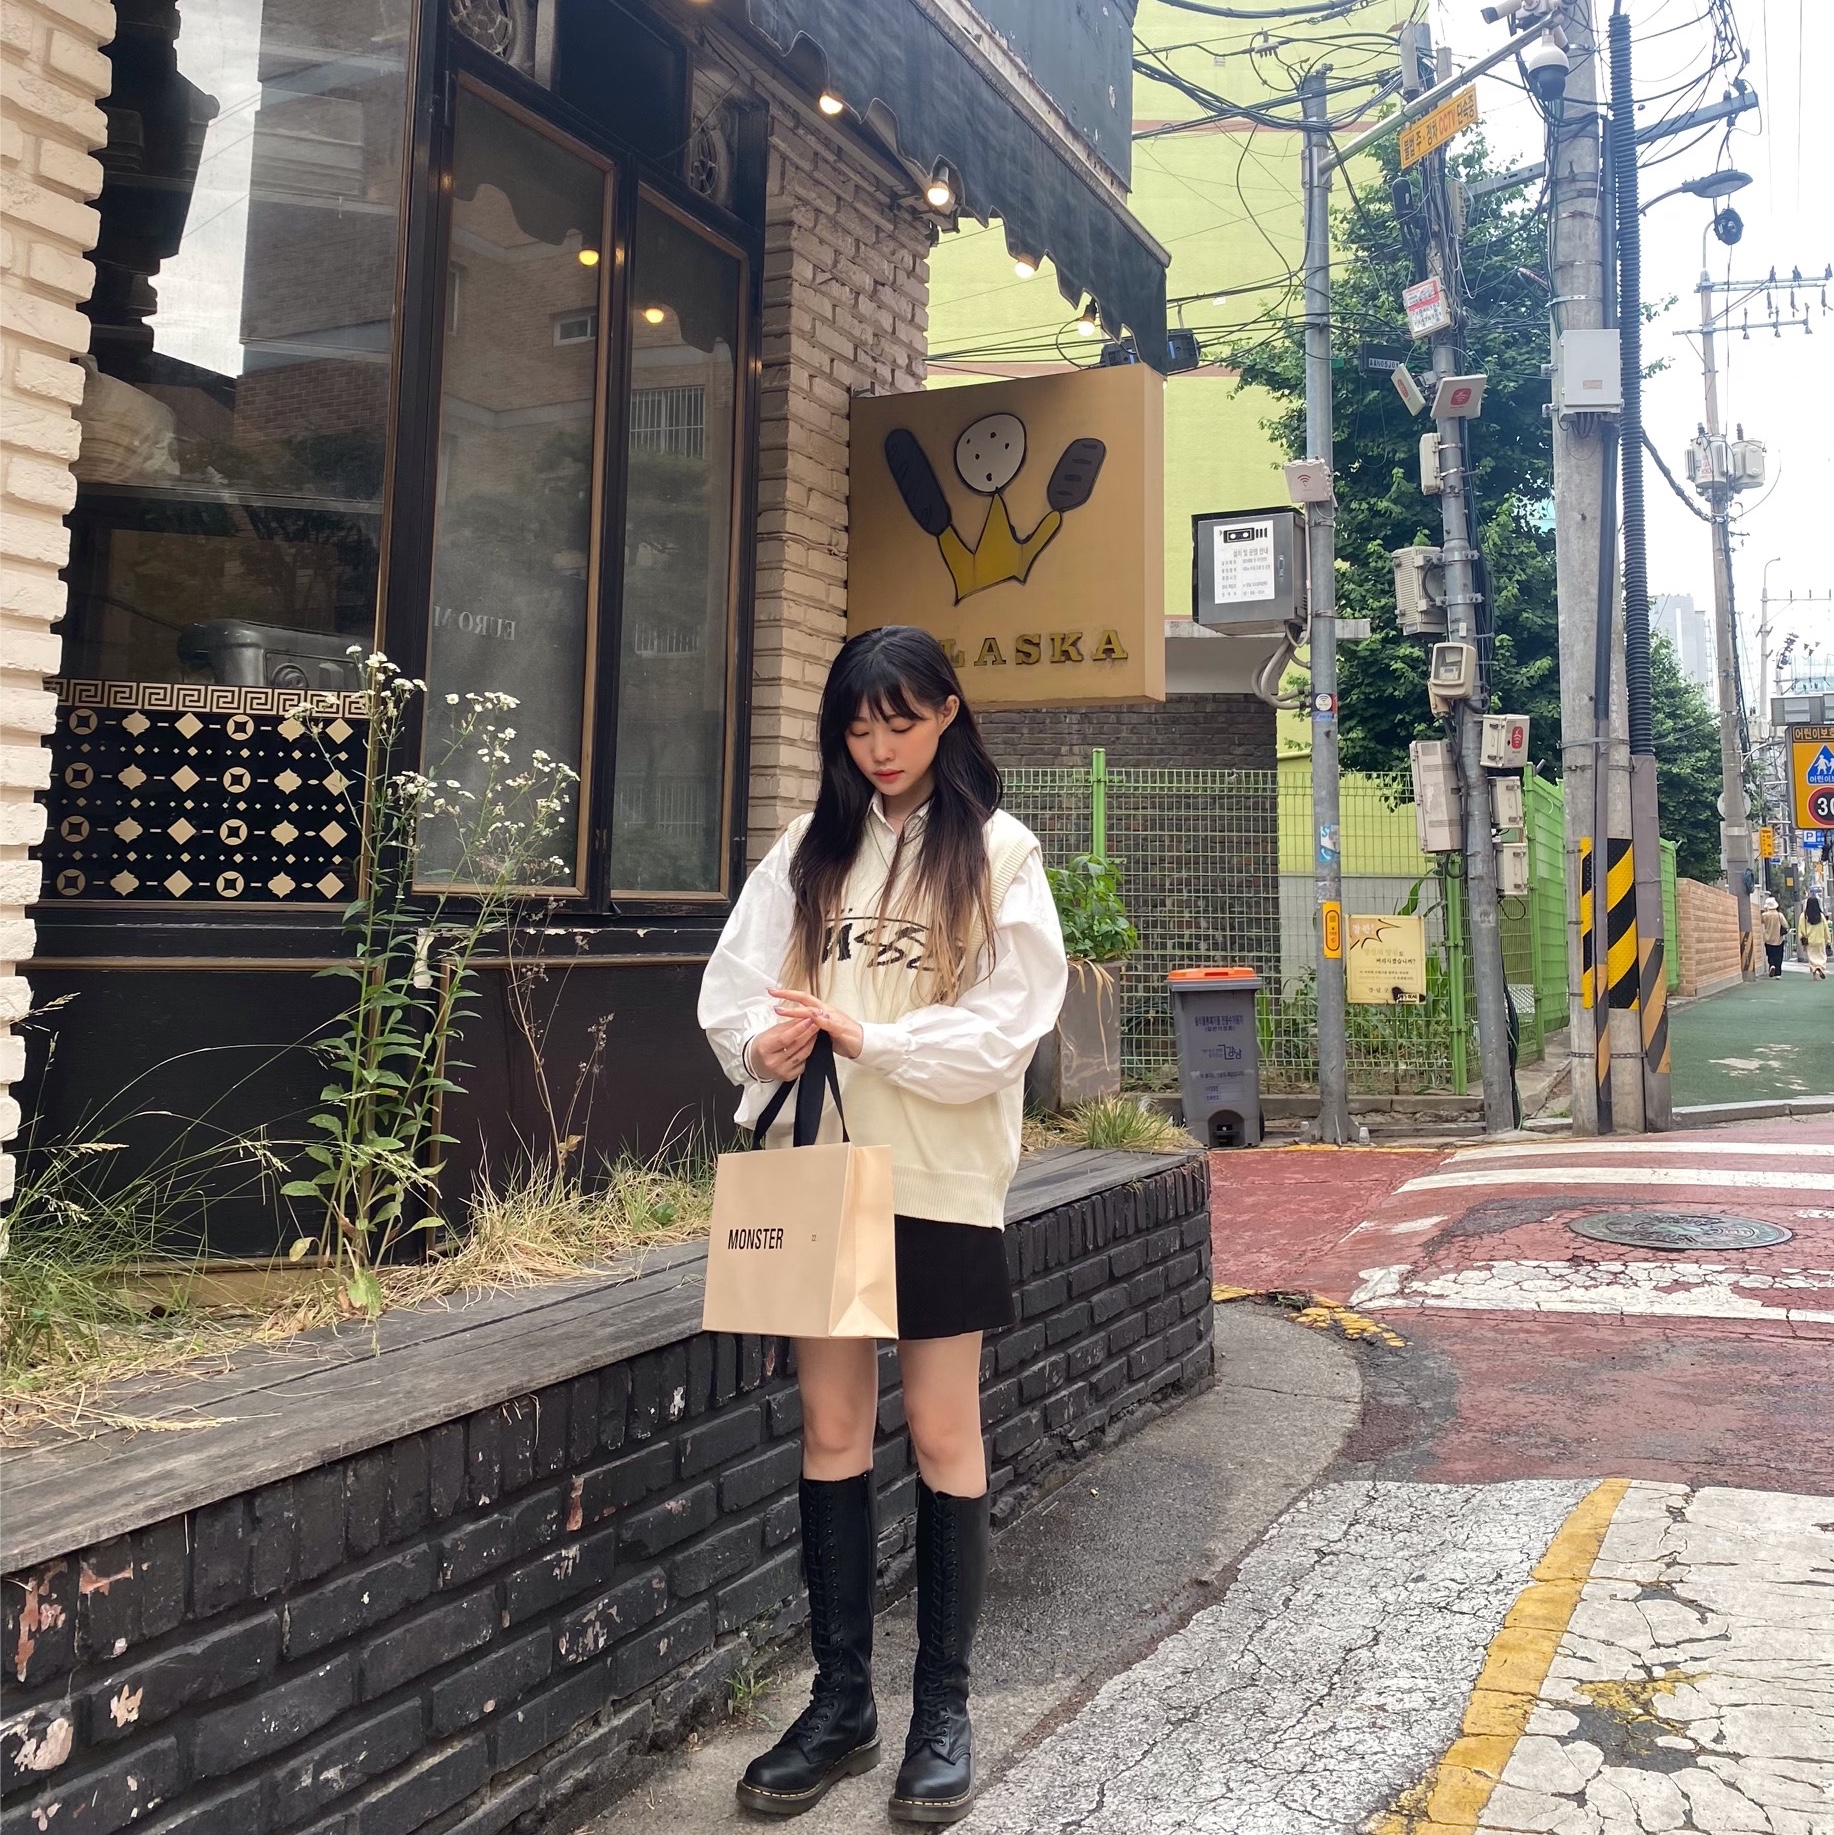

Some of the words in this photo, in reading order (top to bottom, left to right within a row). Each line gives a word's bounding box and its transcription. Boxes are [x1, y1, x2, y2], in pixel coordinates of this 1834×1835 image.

[1438, 105, 1456, 136] CCTV
[939, 629, 1129, 668] LASKA
[727, 1228, 784, 1250] MONSTER
